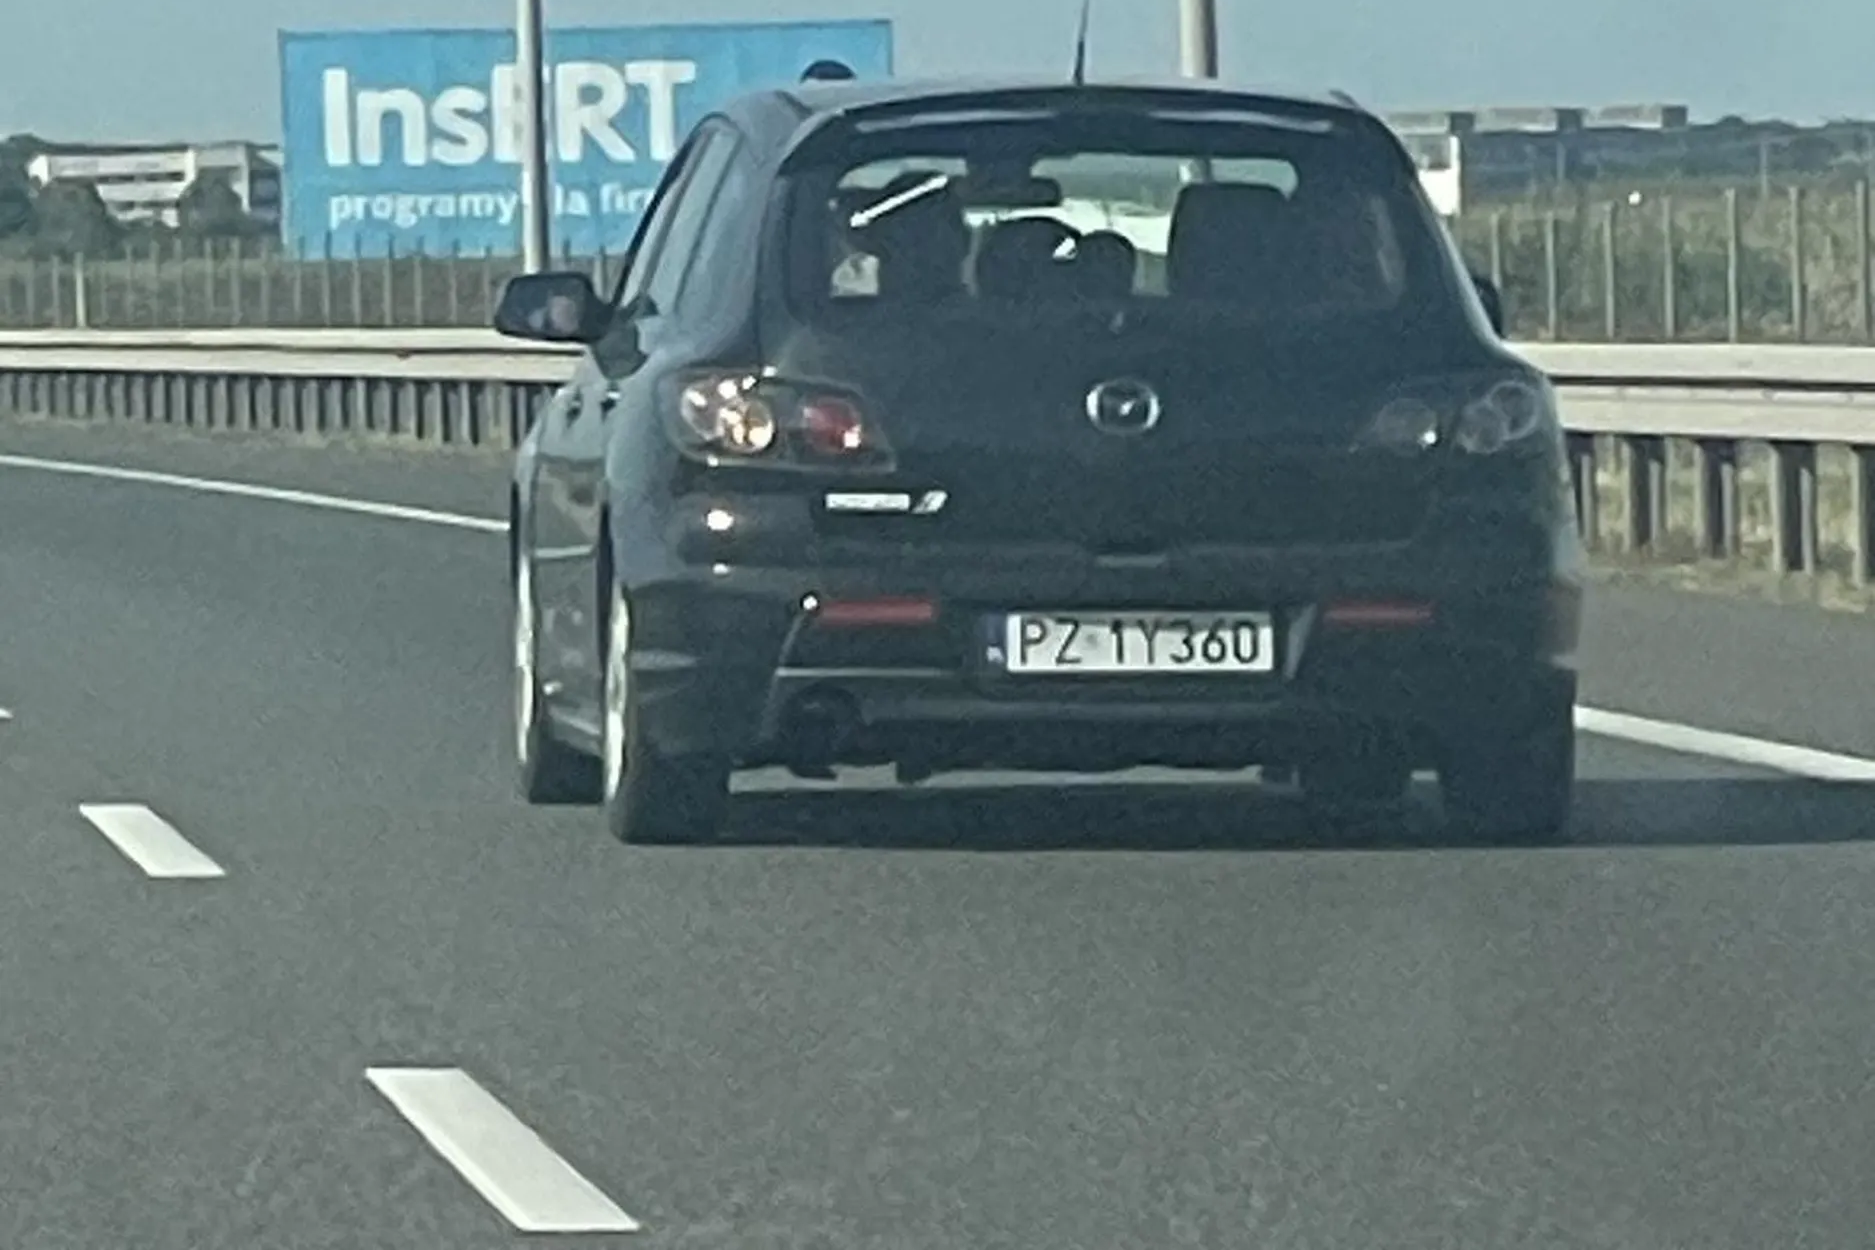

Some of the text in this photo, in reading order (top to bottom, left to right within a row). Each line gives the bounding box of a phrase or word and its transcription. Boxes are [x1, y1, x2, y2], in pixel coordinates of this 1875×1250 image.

[328, 191, 518, 230] programy
[1019, 618, 1258, 665] PZ 1Y360
